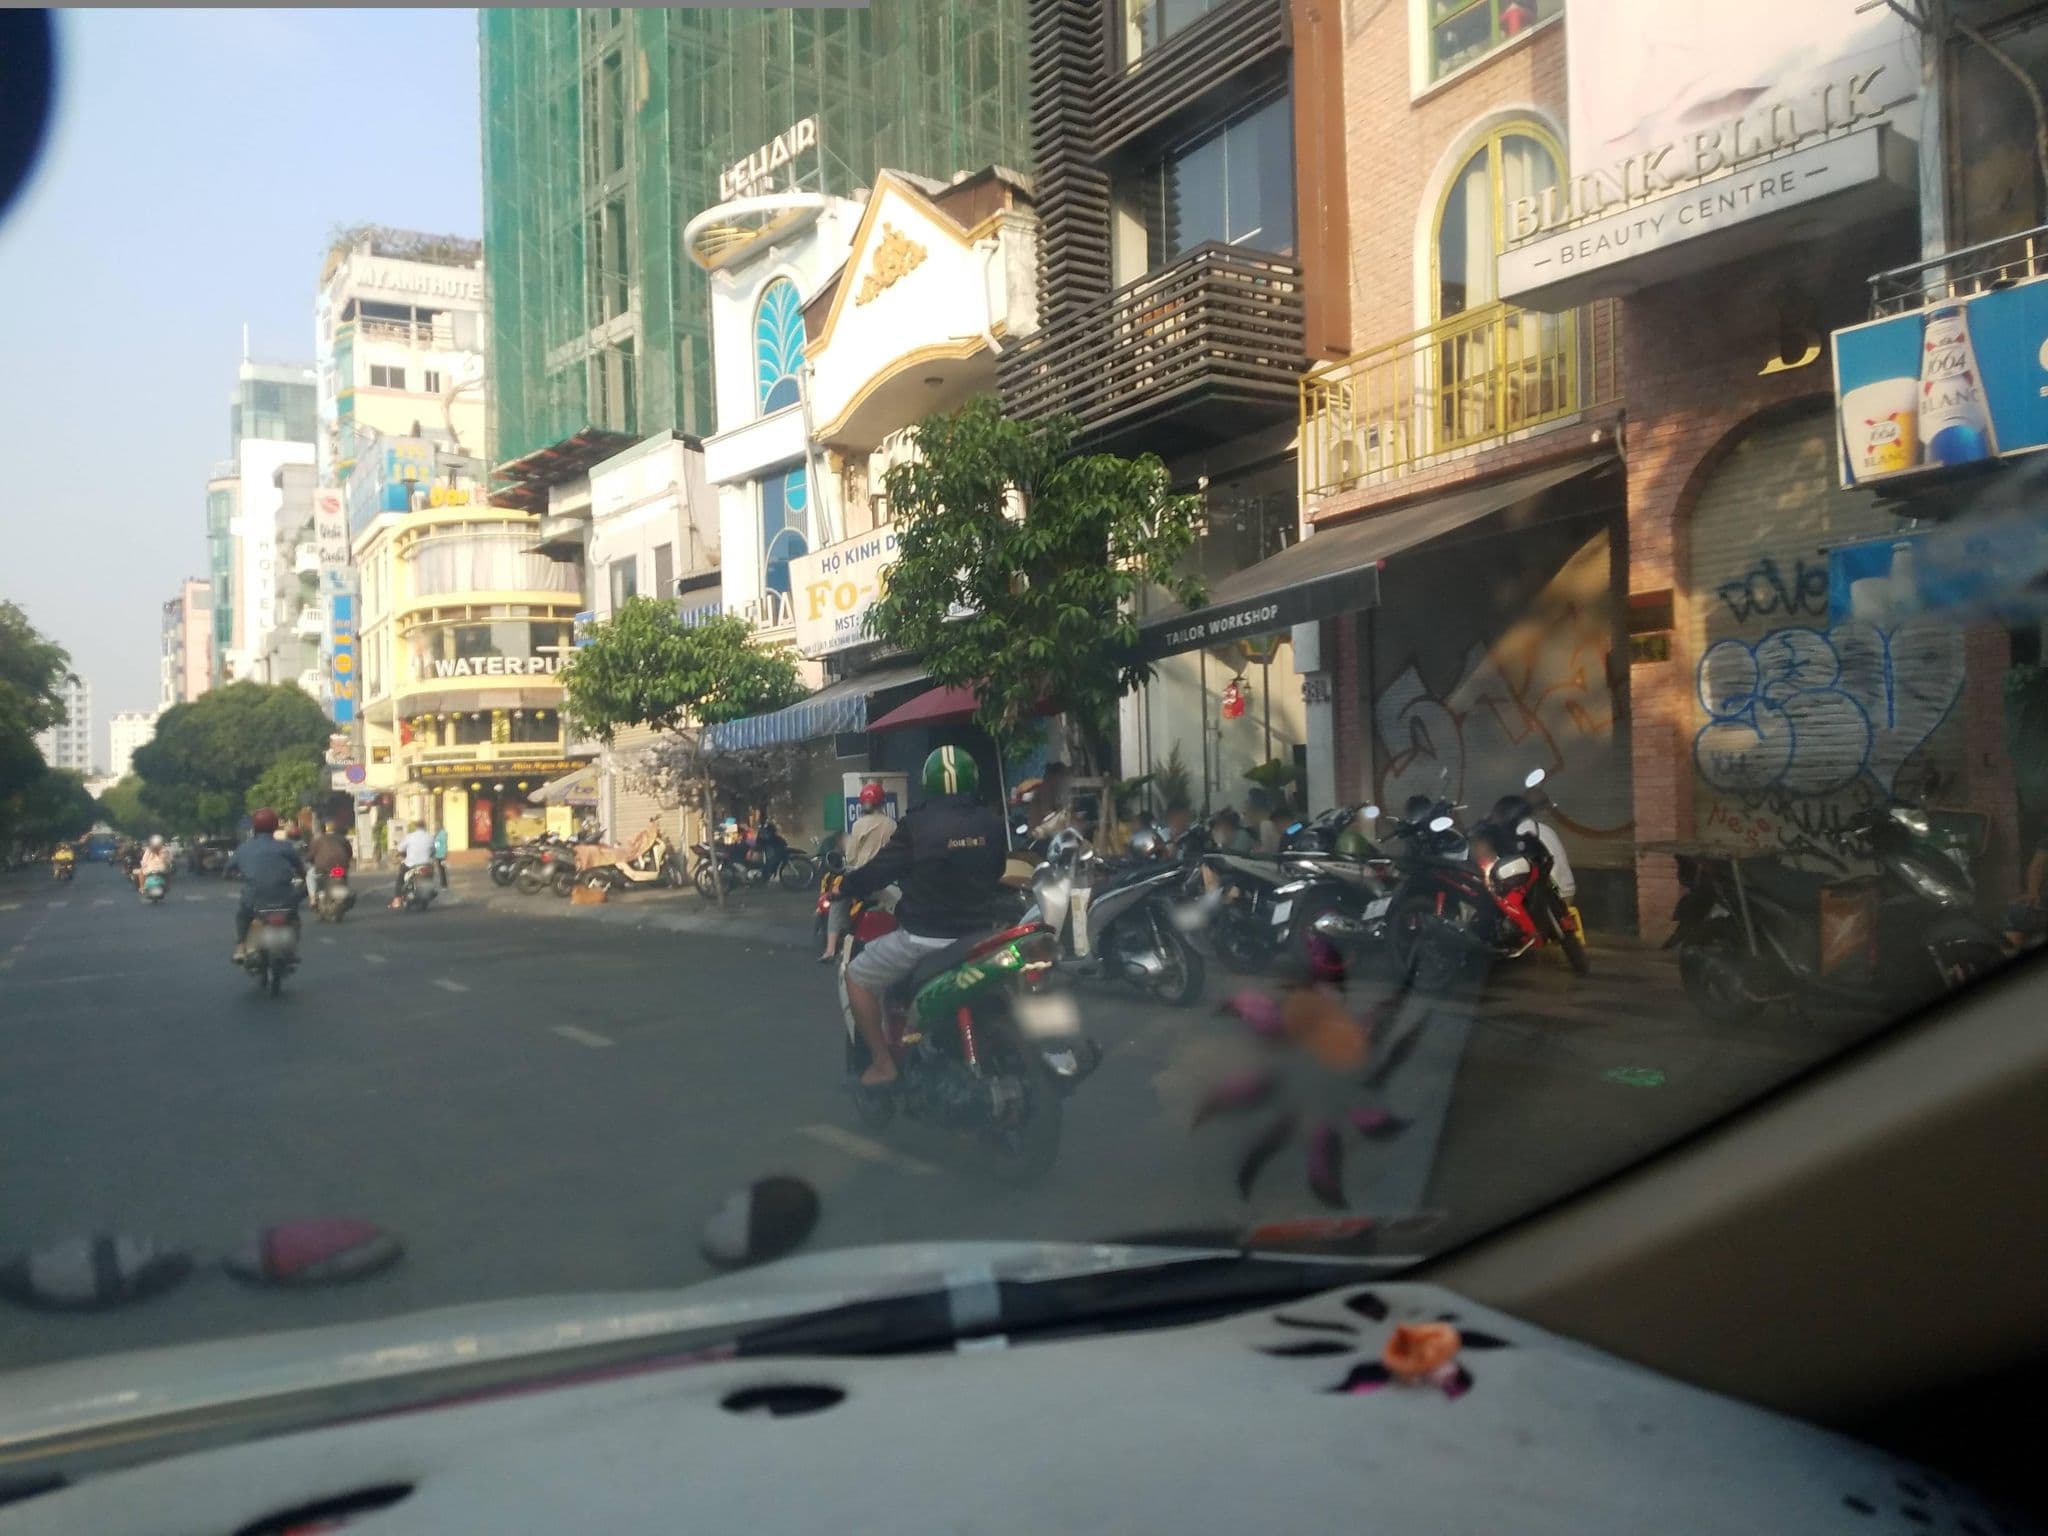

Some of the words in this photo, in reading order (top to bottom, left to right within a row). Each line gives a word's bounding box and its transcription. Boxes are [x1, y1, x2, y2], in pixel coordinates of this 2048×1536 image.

[1507, 144, 1673, 243] BLINK
[1561, 213, 1665, 264] BEAUTY
[1679, 170, 1796, 225] CENTRE
[822, 552, 841, 575] HỘ
[845, 539, 881, 565] KINH
[1165, 625, 1205, 646] TAILOR
[1209, 604, 1280, 635] WORKSHOP
[435, 656, 524, 678] WATER
